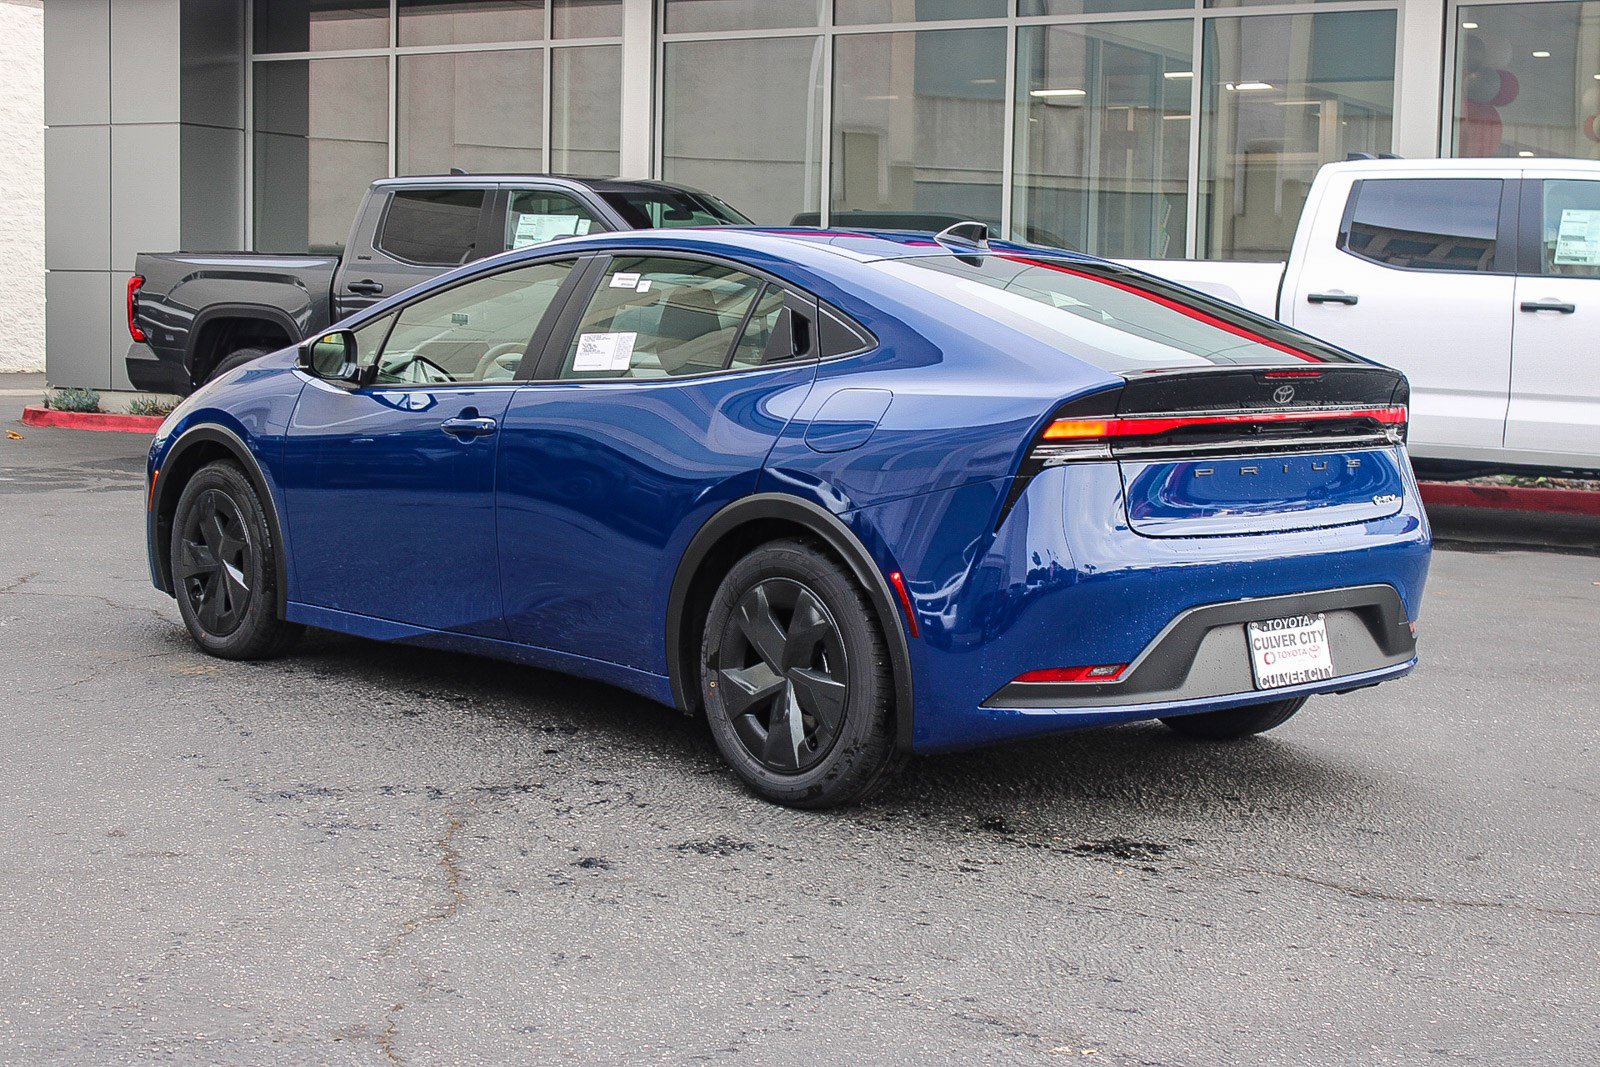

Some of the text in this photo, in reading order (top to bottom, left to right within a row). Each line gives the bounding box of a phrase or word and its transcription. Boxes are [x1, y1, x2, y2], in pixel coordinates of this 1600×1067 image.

[1194, 458, 1361, 478] PRIUS
[1266, 615, 1310, 631] TOYOTA
[1253, 629, 1325, 651] CULVER CITY
[1277, 648, 1308, 659] TOYOTA
[1260, 667, 1306, 689] CULVER
